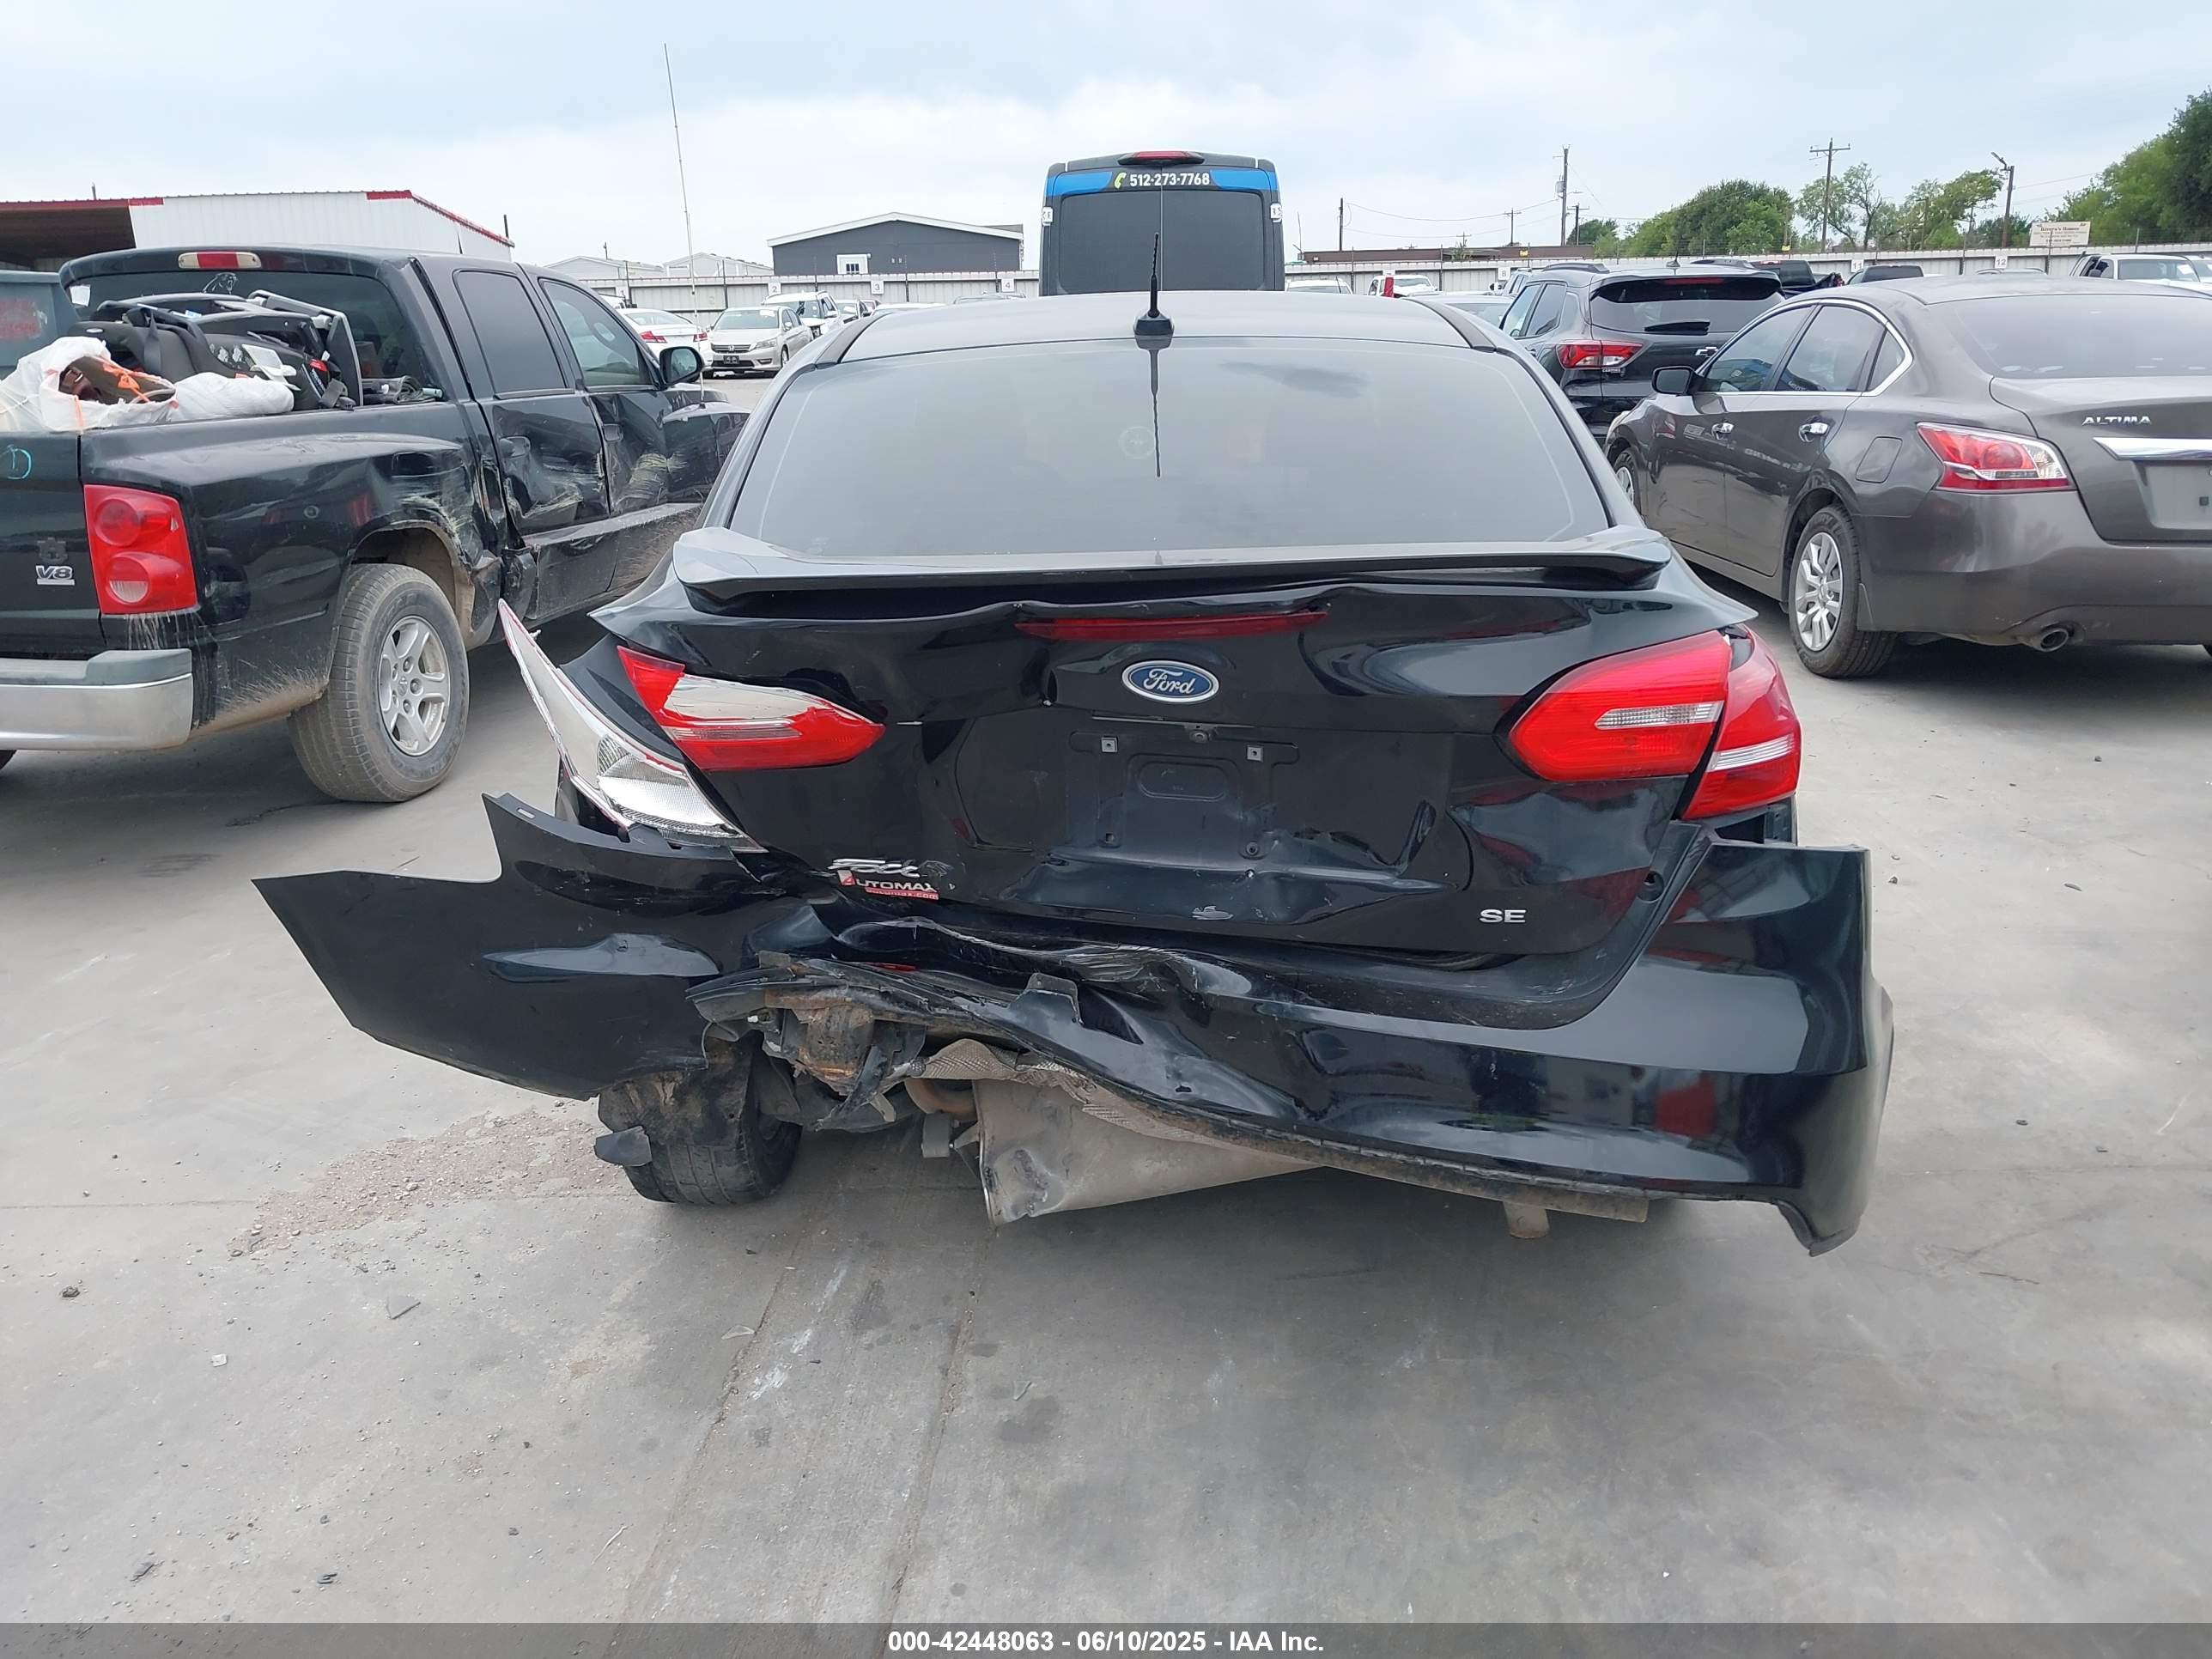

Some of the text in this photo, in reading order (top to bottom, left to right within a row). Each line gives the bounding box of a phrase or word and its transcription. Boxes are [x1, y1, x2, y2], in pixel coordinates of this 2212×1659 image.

[2081, 416, 2151, 425] ALTIMA
[35, 565, 73, 580] V8
[1143, 669, 1196, 694] Ford
[1480, 908, 1527, 923] SE
